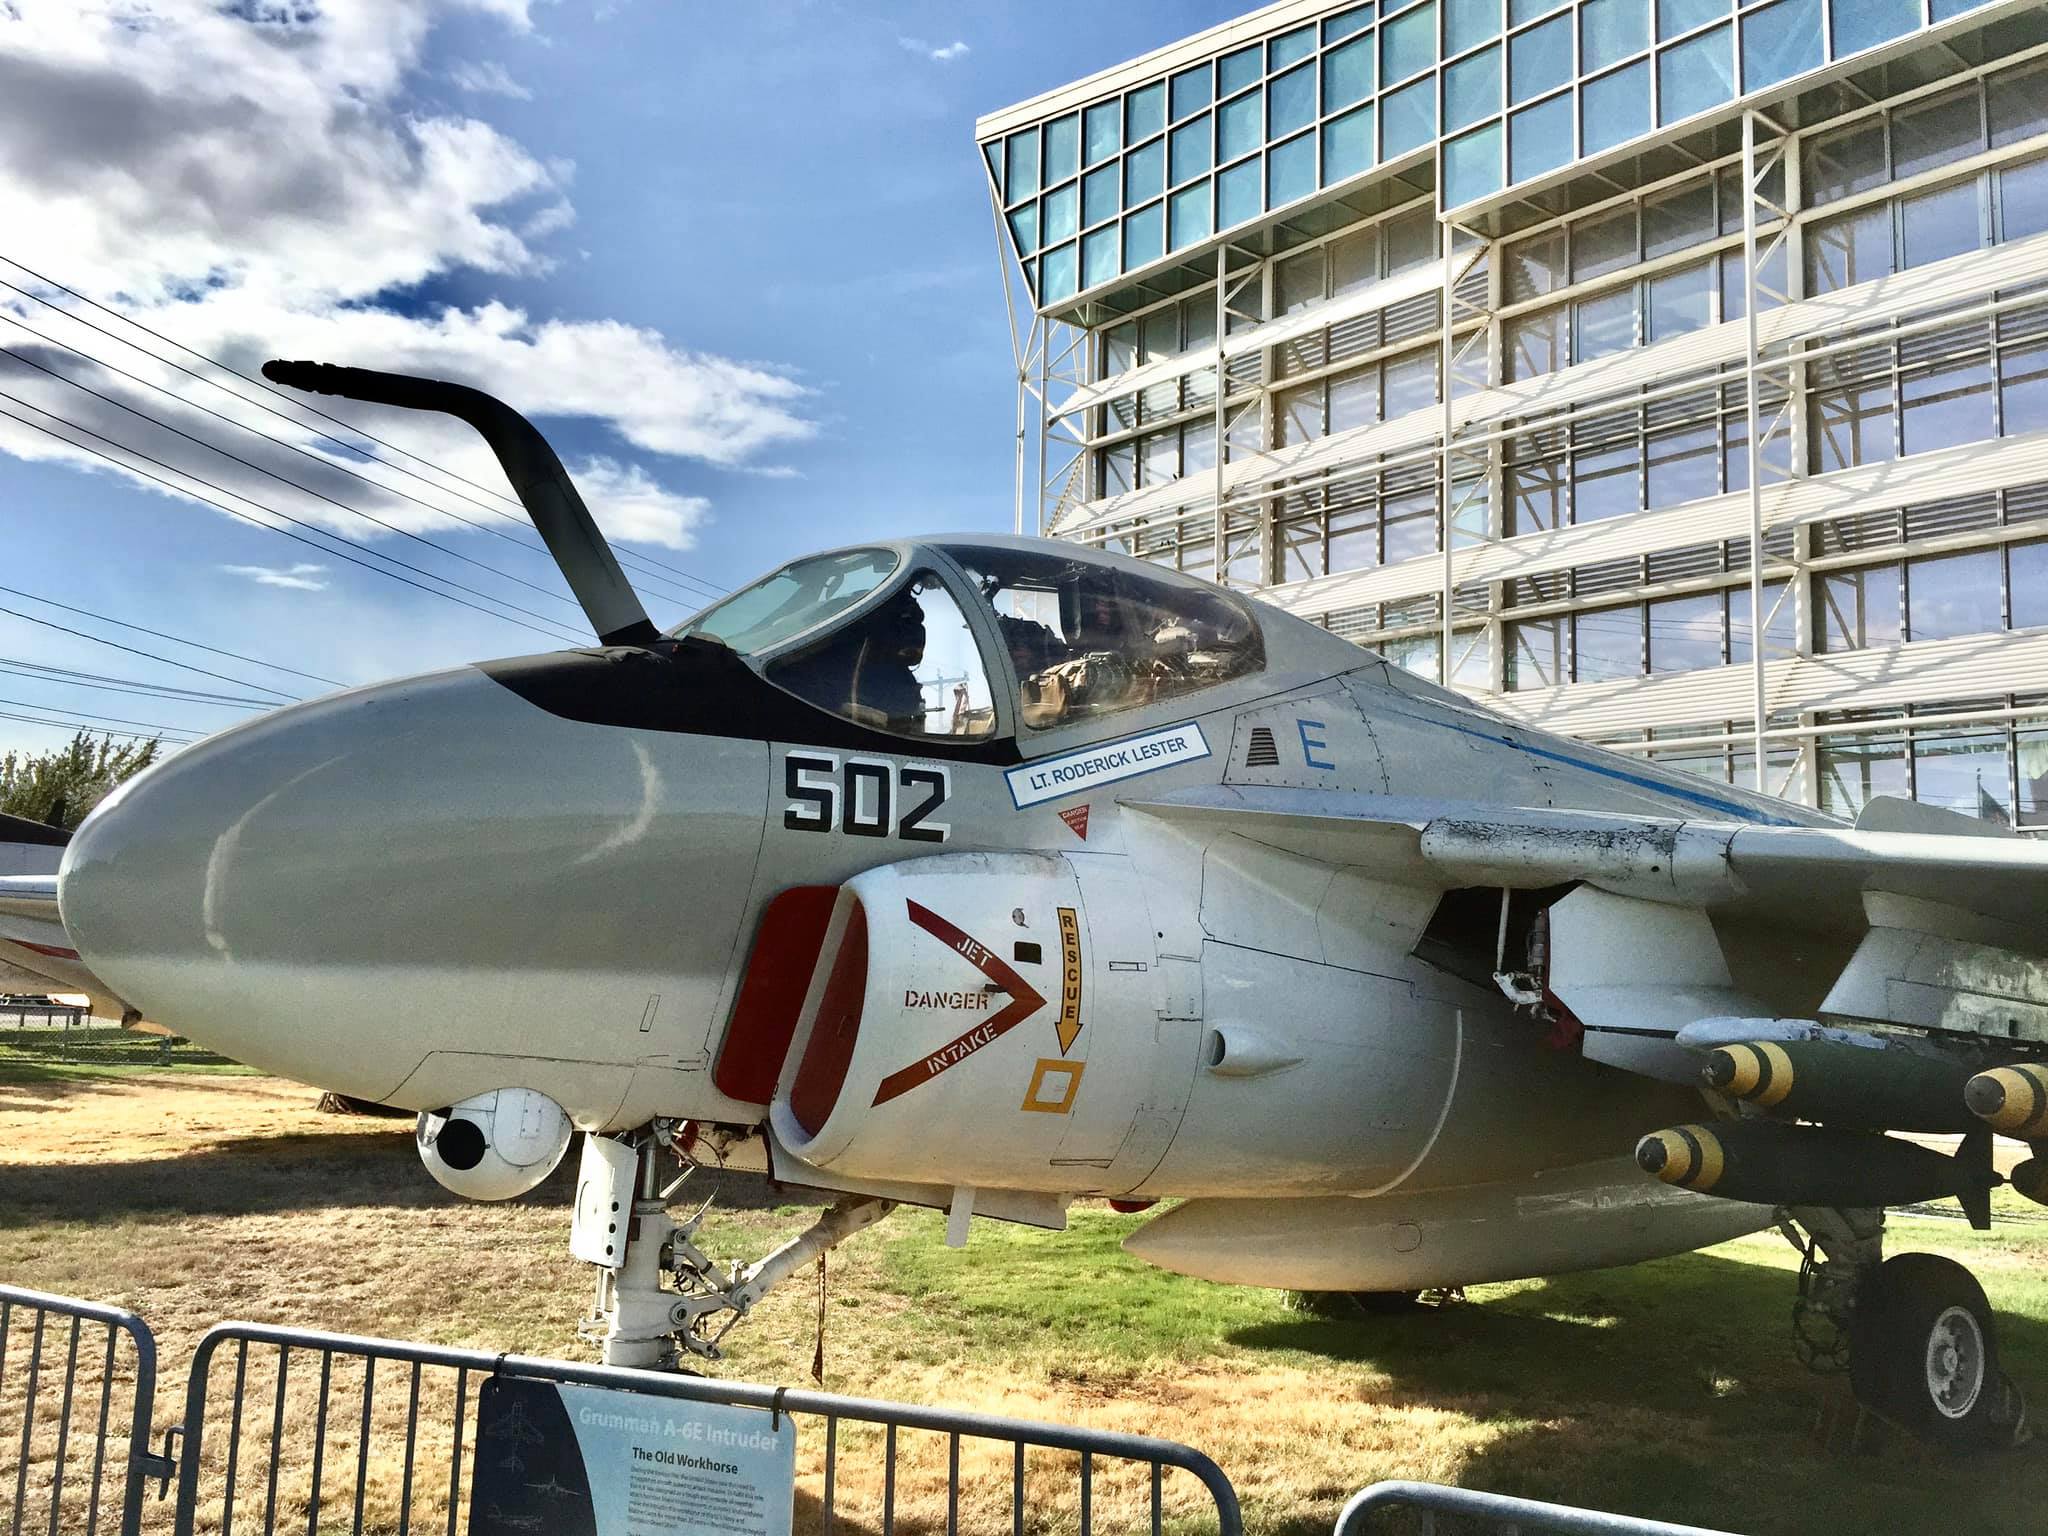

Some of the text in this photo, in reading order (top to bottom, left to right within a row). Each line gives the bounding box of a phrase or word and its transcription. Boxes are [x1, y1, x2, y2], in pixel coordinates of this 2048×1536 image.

[1030, 736, 1188, 791] LT. RODERICK LESTER
[1296, 718, 1336, 770] E
[784, 750, 951, 843] 502
[956, 938, 993, 967] JET
[1061, 915, 1078, 1019] RESCUE
[904, 990, 990, 1010] DANGER
[926, 1022, 998, 1074] INTAKE
[578, 1406, 779, 1451] Grumman A-6E Intruder
[632, 1447, 739, 1475] The Old Workhorse
